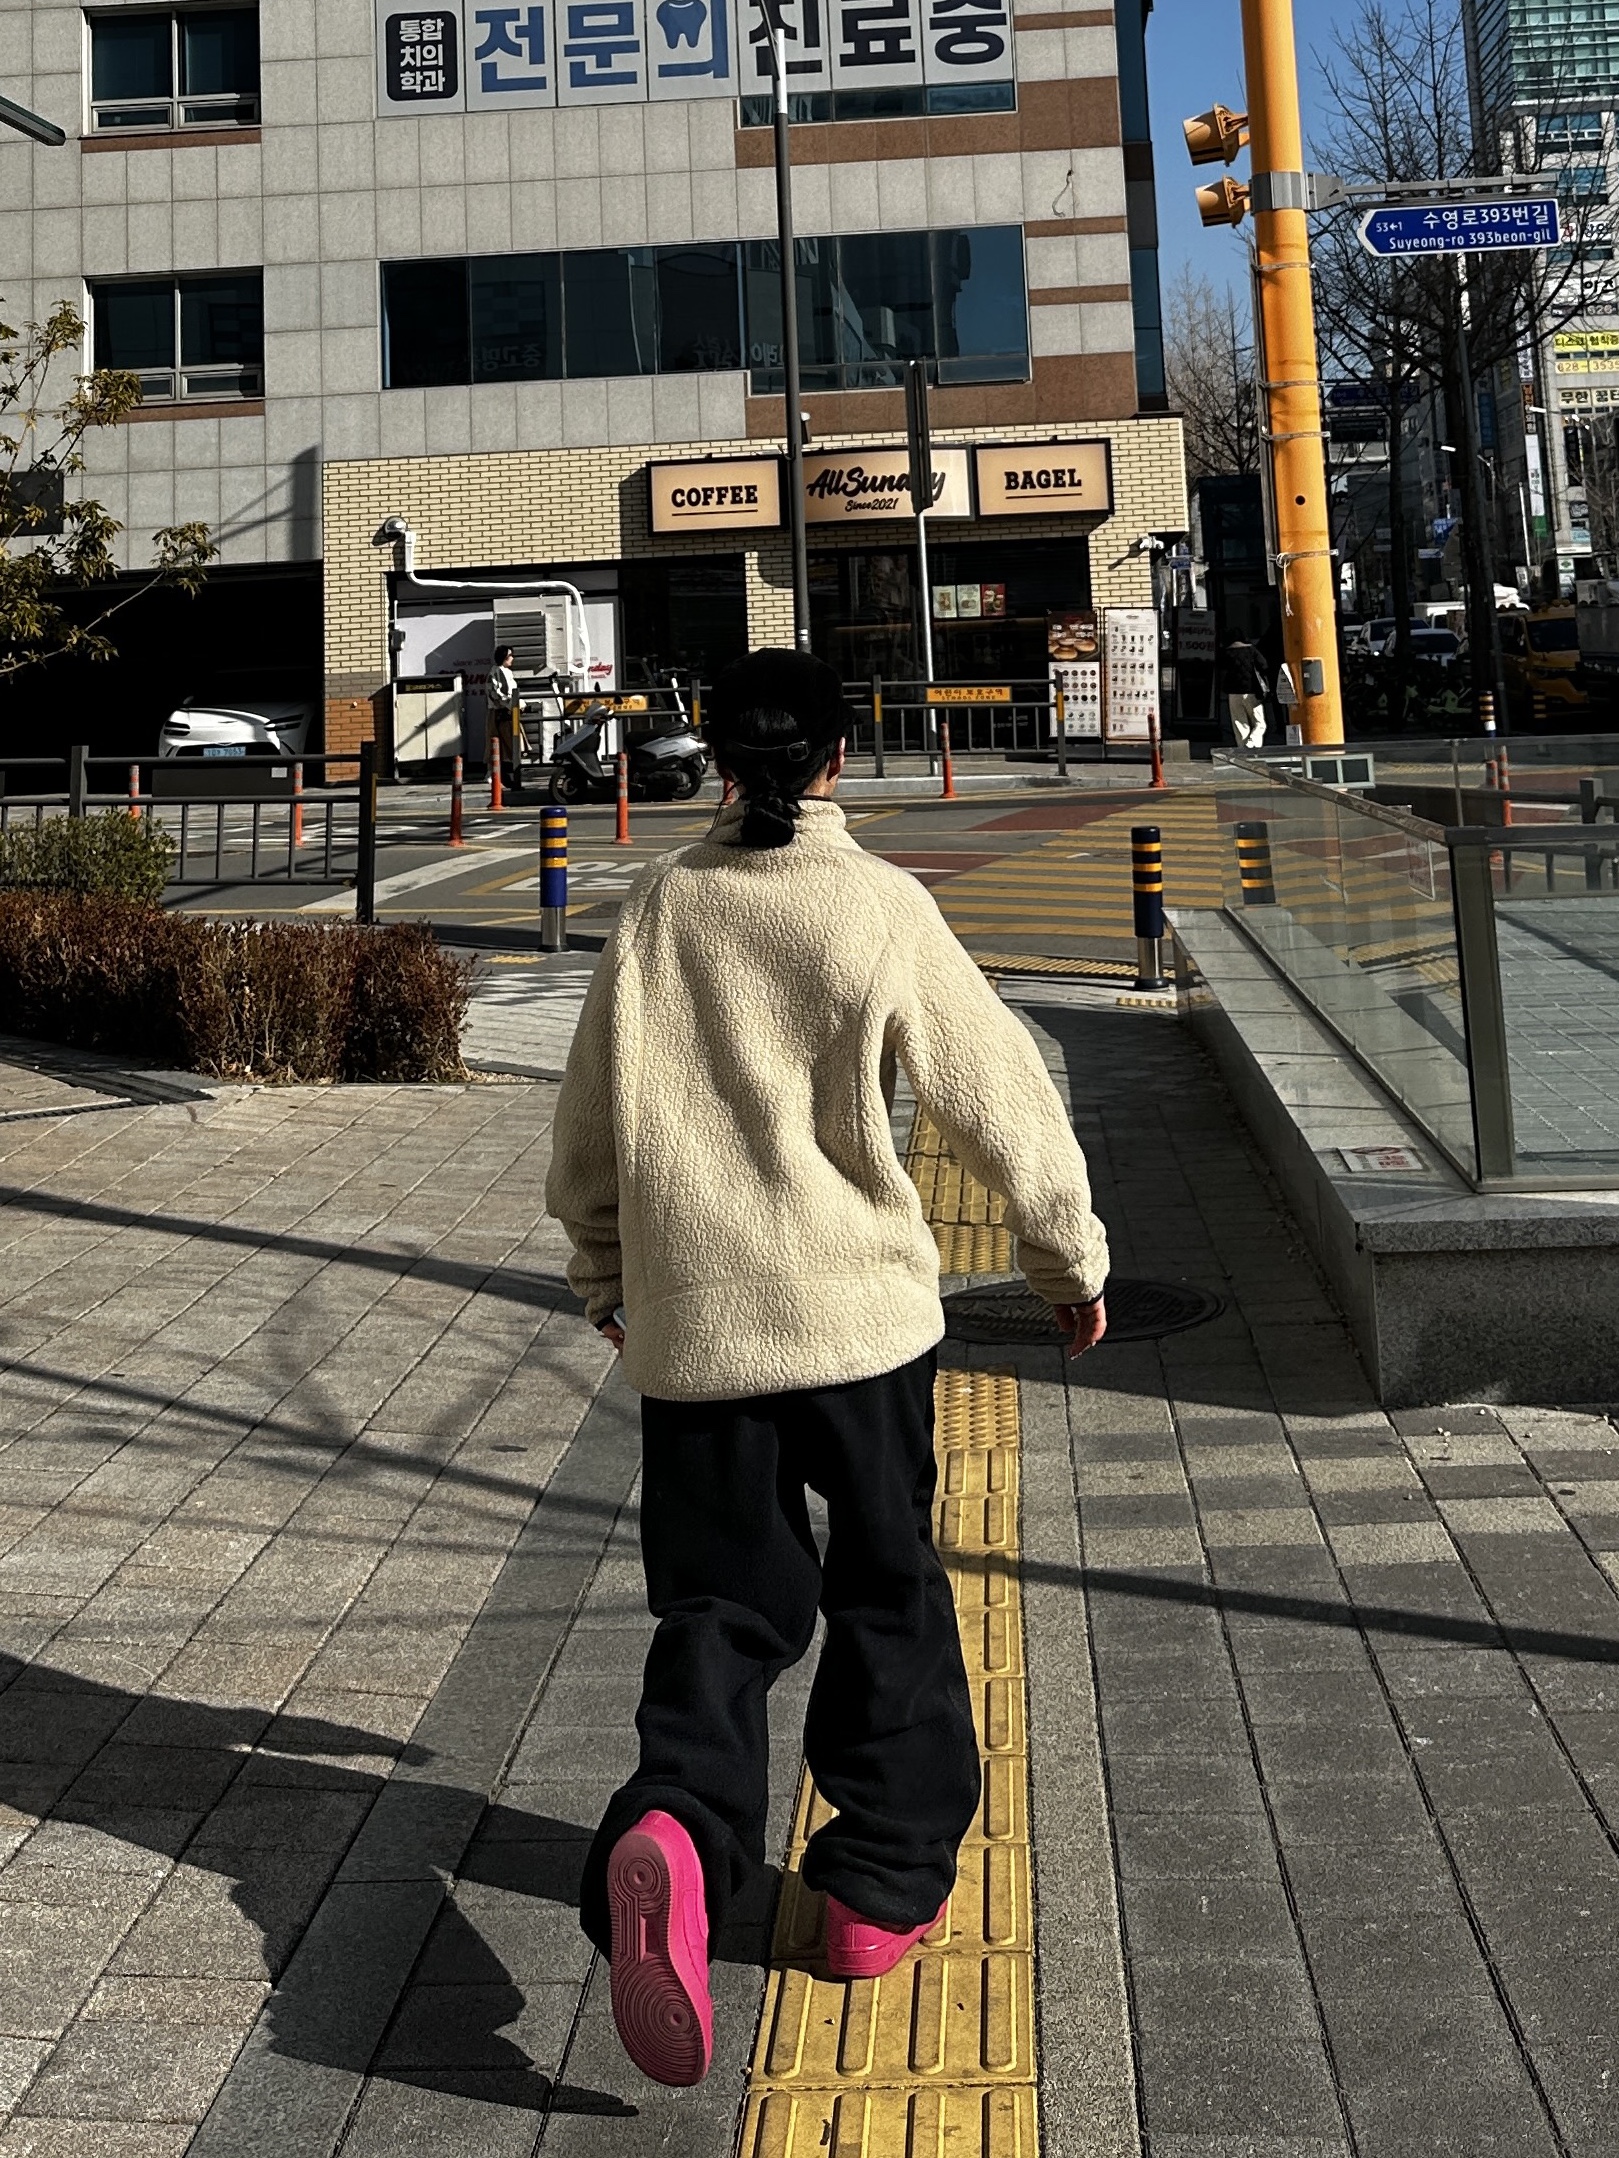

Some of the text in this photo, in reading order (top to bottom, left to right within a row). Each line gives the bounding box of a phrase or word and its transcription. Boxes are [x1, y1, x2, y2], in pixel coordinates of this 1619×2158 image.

[399, 17, 445, 43] 통합
[400, 44, 444, 68] 치의
[474, 0, 1007, 94] 전문의 진료중
[400, 69, 446, 94] 학과
[1422, 204, 1550, 231] 수영로393번길
[1389, 235, 1465, 251] Suyeong-ro
[1469, 228, 1552, 246] 393beon-gil
[806, 466, 946, 502] AllSuny
[1003, 468, 1083, 491] BAGEL
[671, 484, 759, 508] COFFEE
